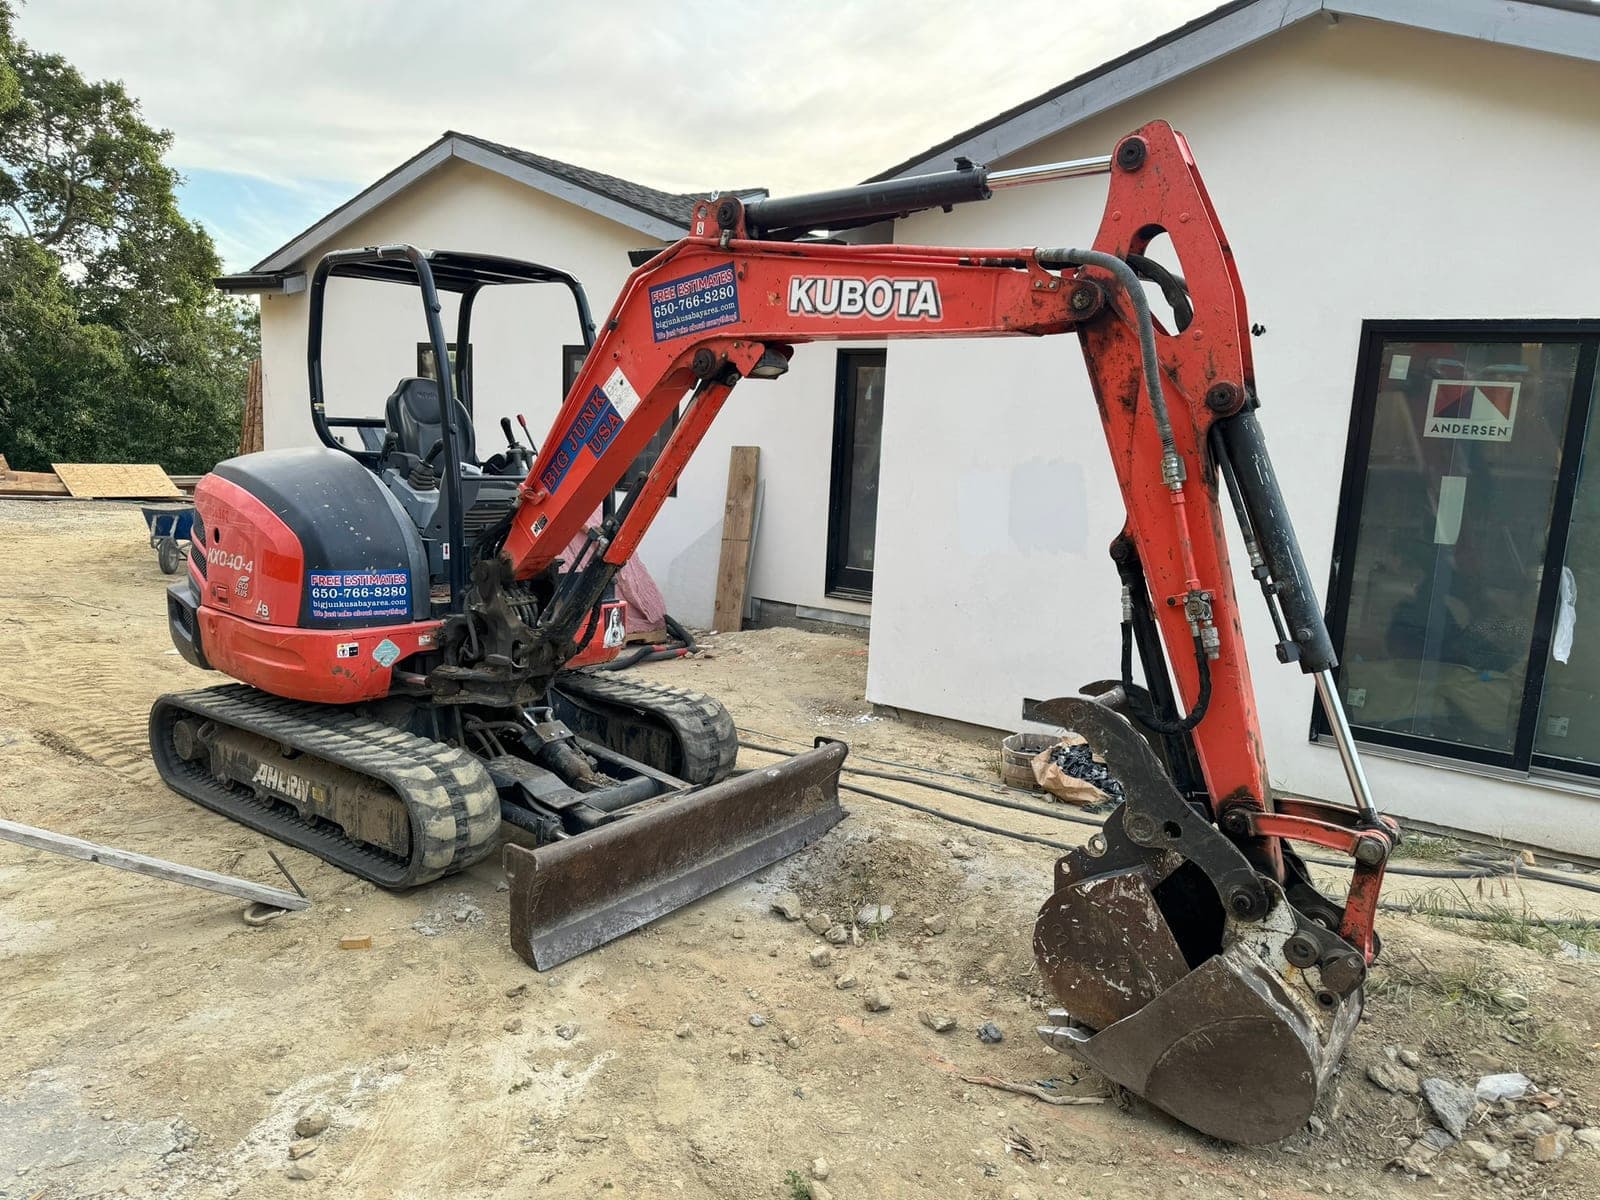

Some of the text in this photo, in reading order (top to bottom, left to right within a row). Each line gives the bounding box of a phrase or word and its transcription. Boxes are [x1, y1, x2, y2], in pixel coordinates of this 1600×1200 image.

[651, 269, 734, 304] FREE ESTIMATES
[789, 276, 942, 318] KUBOTA
[653, 285, 734, 318] 650-766-8280
[655, 302, 735, 329] bigjunkusabayarea.com
[543, 391, 607, 489] BIG JUNK
[589, 412, 622, 453] USA
[1430, 423, 1508, 436] ANDERSEN
[207, 547, 253, 574] KX040-4
[311, 574, 407, 586] FREE ESTIMATES
[312, 586, 407, 599] 650-766-8280
[313, 599, 406, 609] bigjunkusabayarea.com
